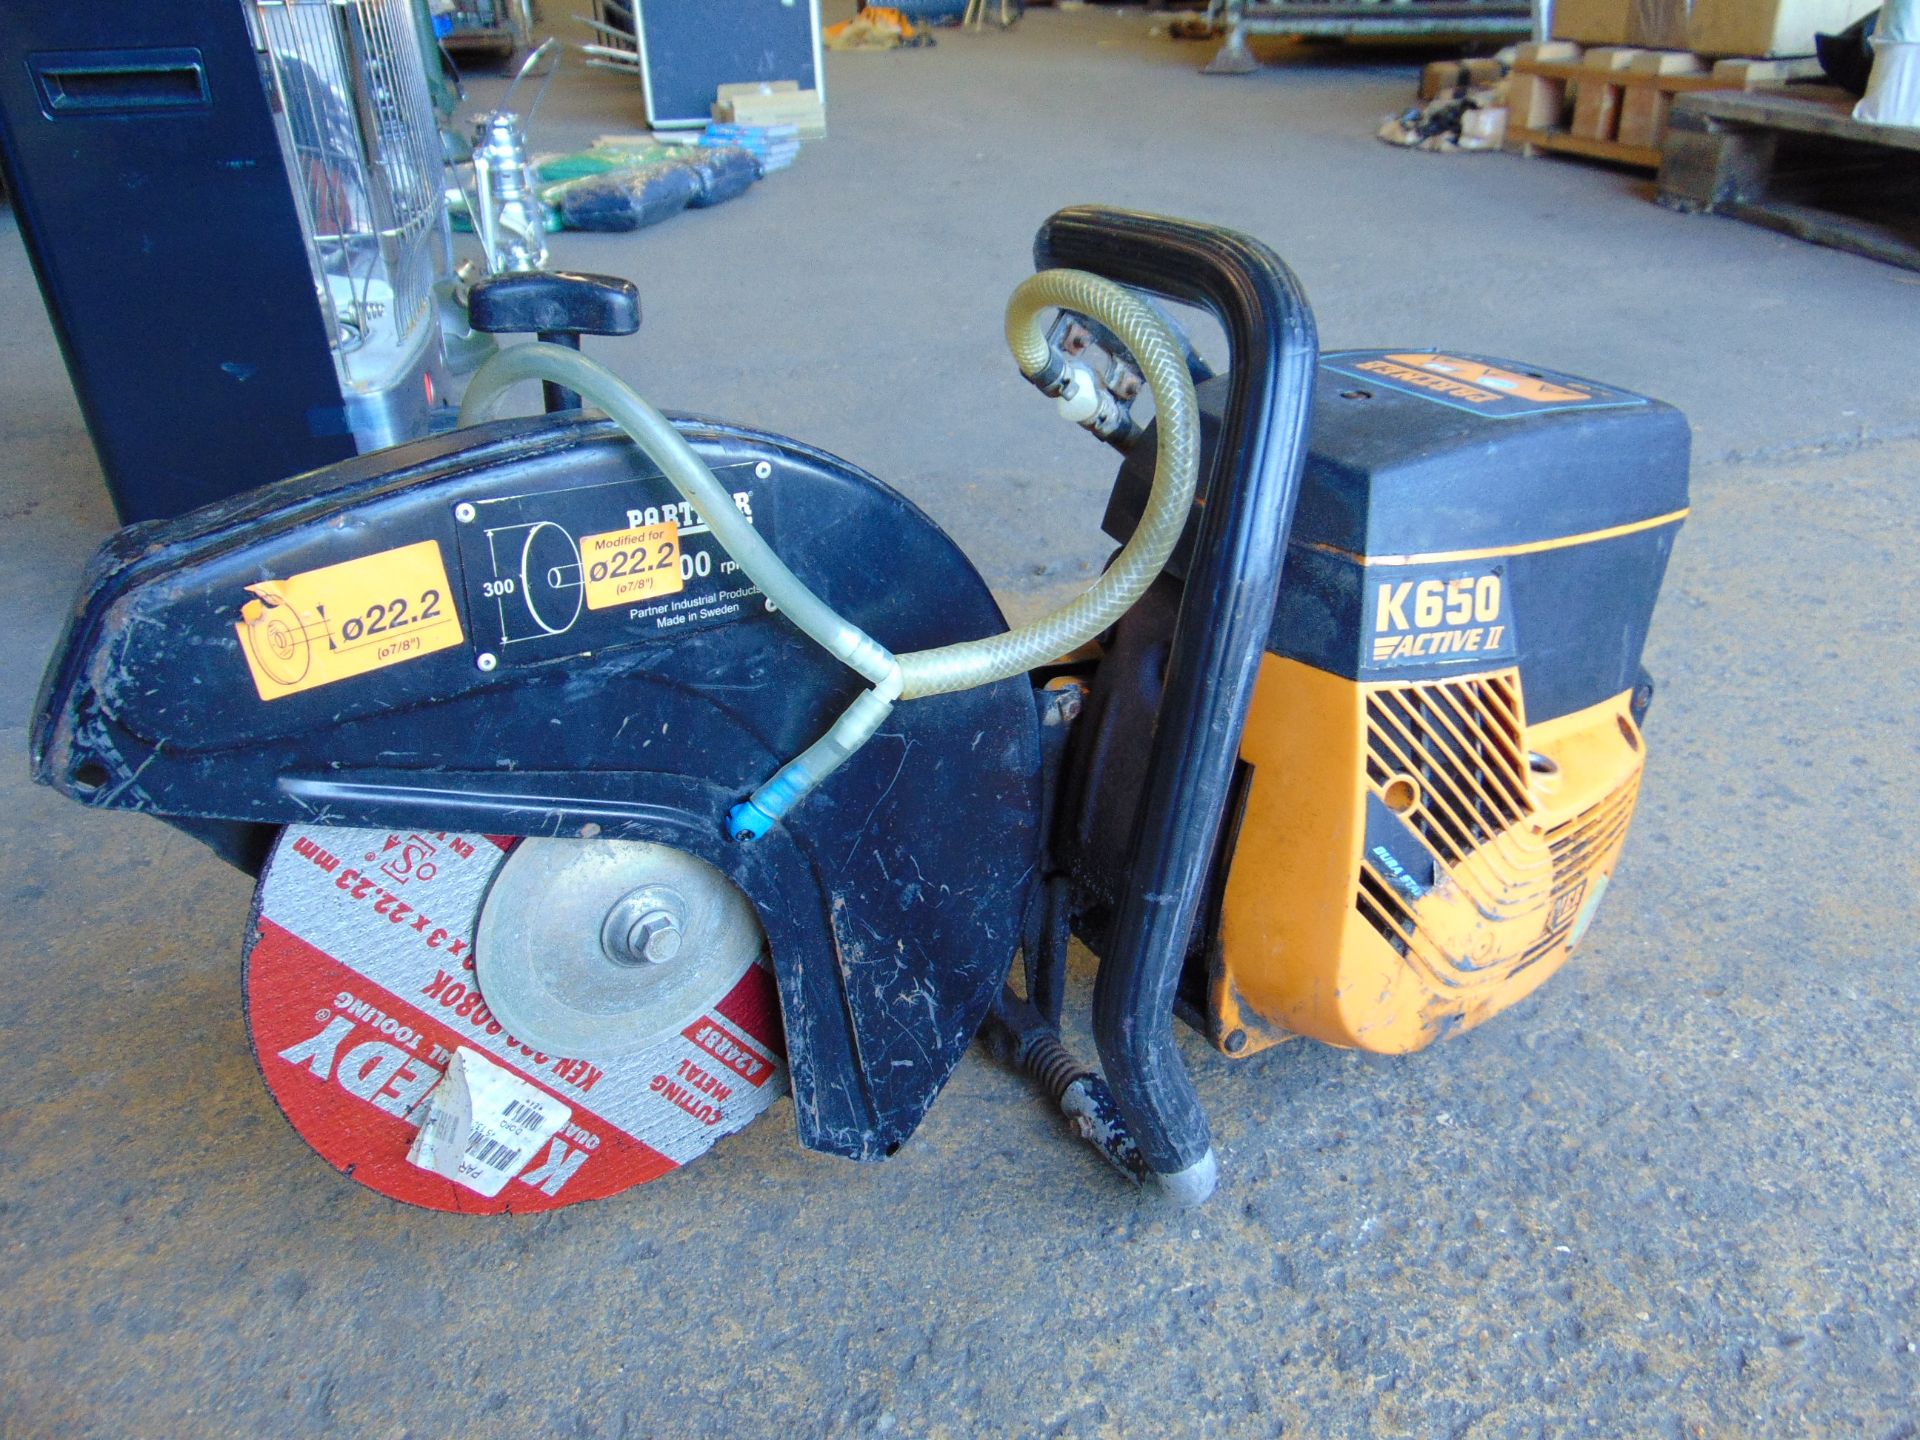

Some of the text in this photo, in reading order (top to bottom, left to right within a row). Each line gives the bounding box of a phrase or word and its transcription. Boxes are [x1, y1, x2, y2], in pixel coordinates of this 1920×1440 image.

[594, 528, 664, 551] Modified for
[482, 578, 515, 598] 300
[630, 586, 763, 620] Partner Industrial Products
[656, 602, 740, 629] Made in Sweden
[1392, 629, 1483, 657] ACTIVE
[448, 836, 476, 860] EN
[292, 836, 468, 957] x 3 x 22.23 mm
[333, 991, 425, 1051] TOOLING
[550, 1055, 604, 1093] KEN
[677, 1058, 733, 1103] METAL
[649, 1075, 722, 1126] CUTTING
